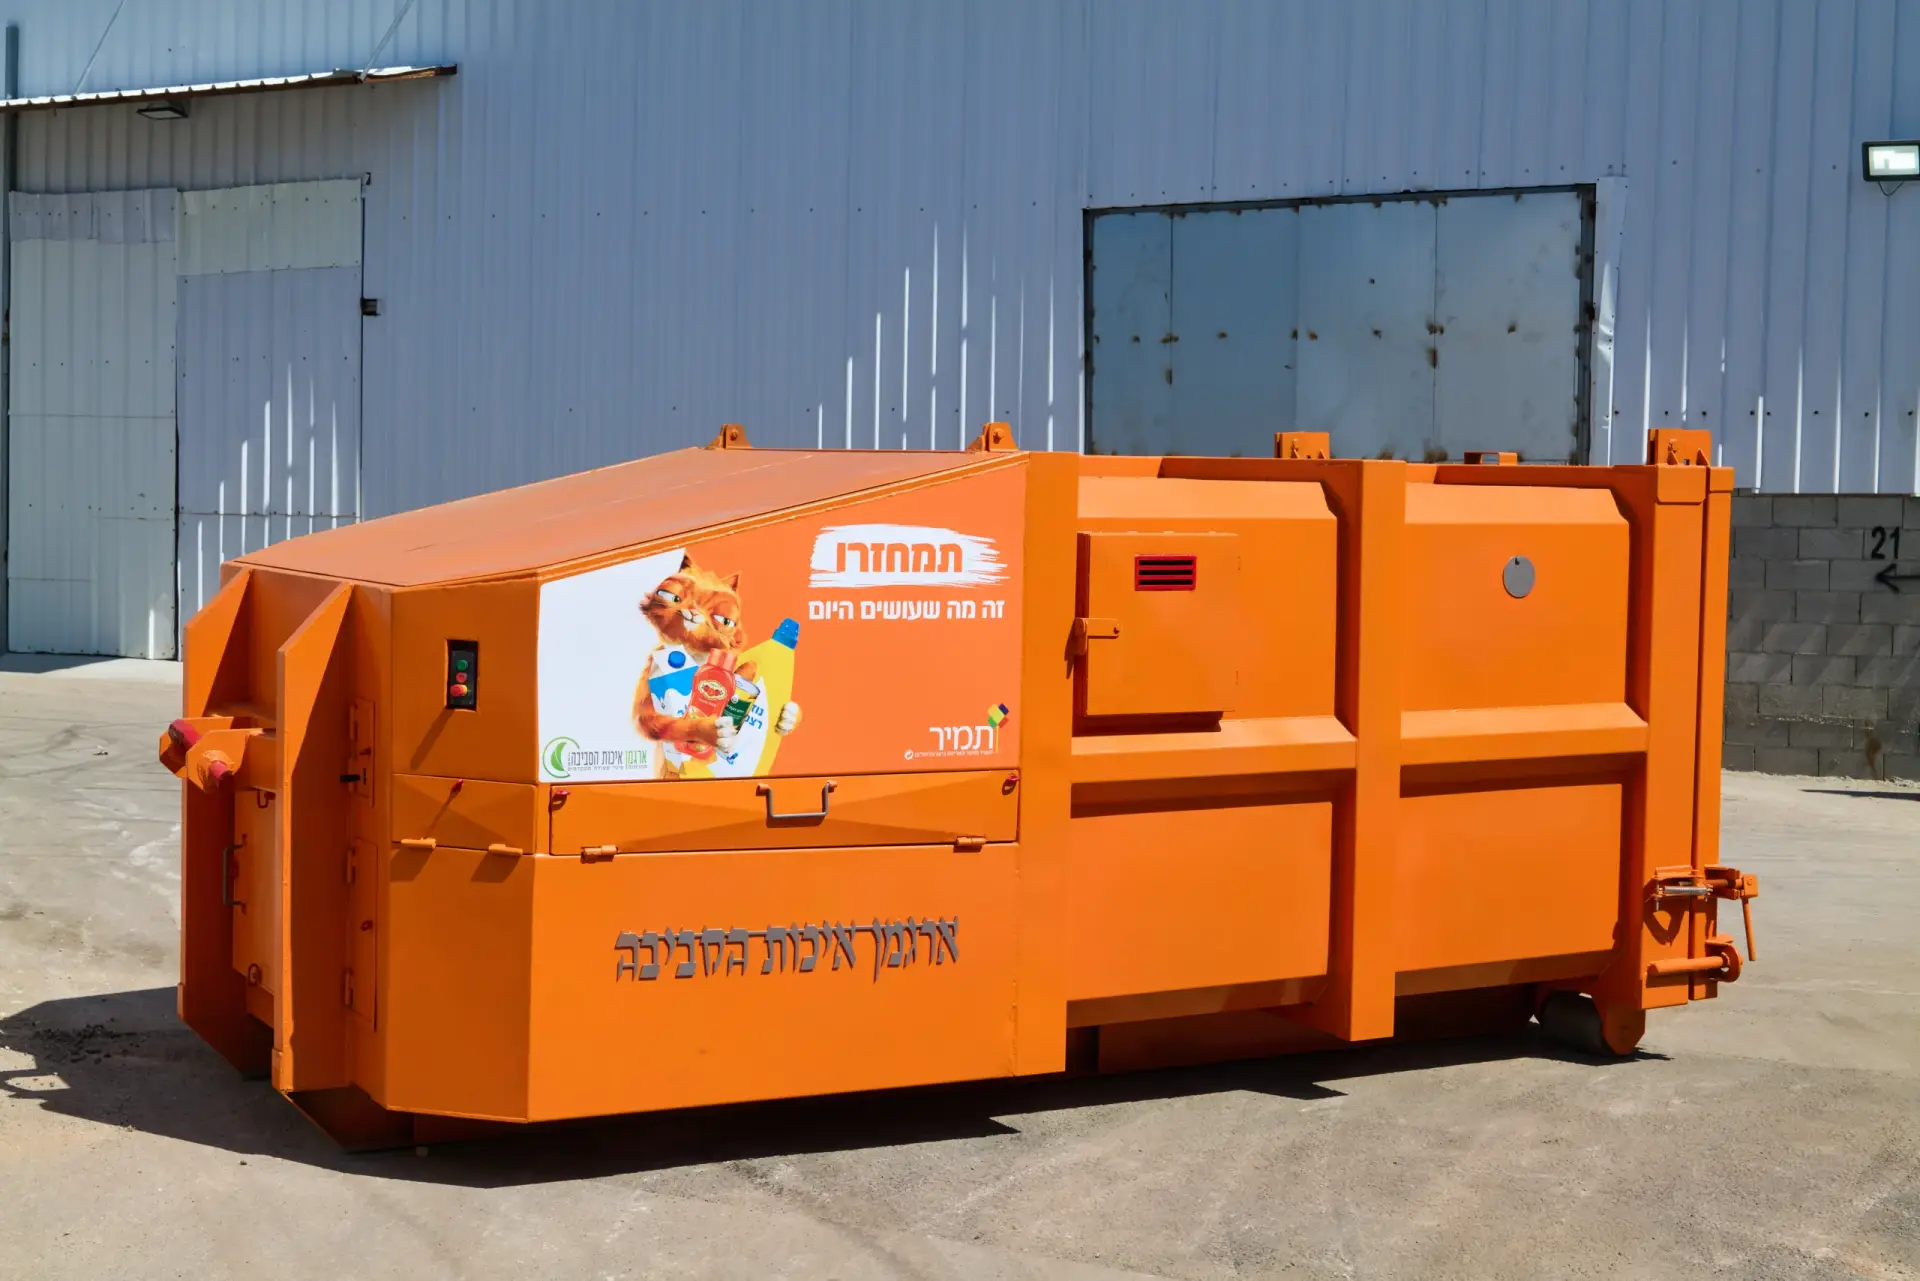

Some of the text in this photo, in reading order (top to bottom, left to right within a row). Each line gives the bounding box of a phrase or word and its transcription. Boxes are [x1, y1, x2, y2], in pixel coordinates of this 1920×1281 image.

[1871, 526, 1900, 560] 21
[836, 542, 963, 573] תמחזרו
[808, 600, 1005, 620] זה מה שעושים היום
[929, 725, 994, 751] תמיר
[570, 751, 599, 767] הסביבה
[601, 750, 623, 766] איכות
[624, 750, 648, 767] ארגמן
[614, 916, 960, 985] ארגמן איכות הסביבה
